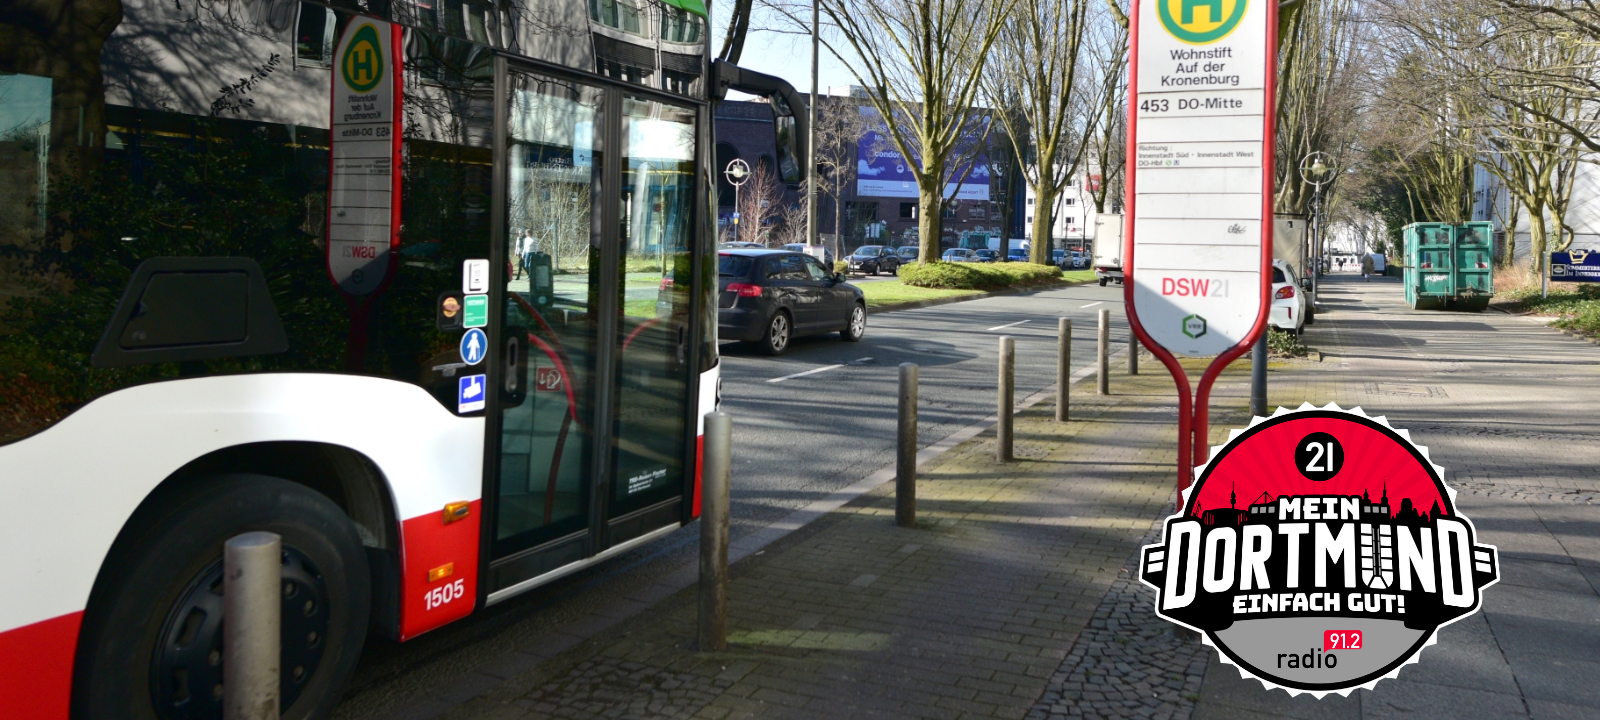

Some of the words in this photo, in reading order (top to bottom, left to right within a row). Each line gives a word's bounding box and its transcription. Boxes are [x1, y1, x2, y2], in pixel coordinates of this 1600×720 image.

[1170, 47, 1232, 60] Wohnstift
[1176, 63, 1198, 74] Auf
[1203, 62, 1226, 72] der
[1161, 74, 1240, 86] Kronenburg
[1140, 99, 1169, 112] 453
[1178, 98, 1243, 110] DO-Mitte
[424, 578, 464, 611] 1505
